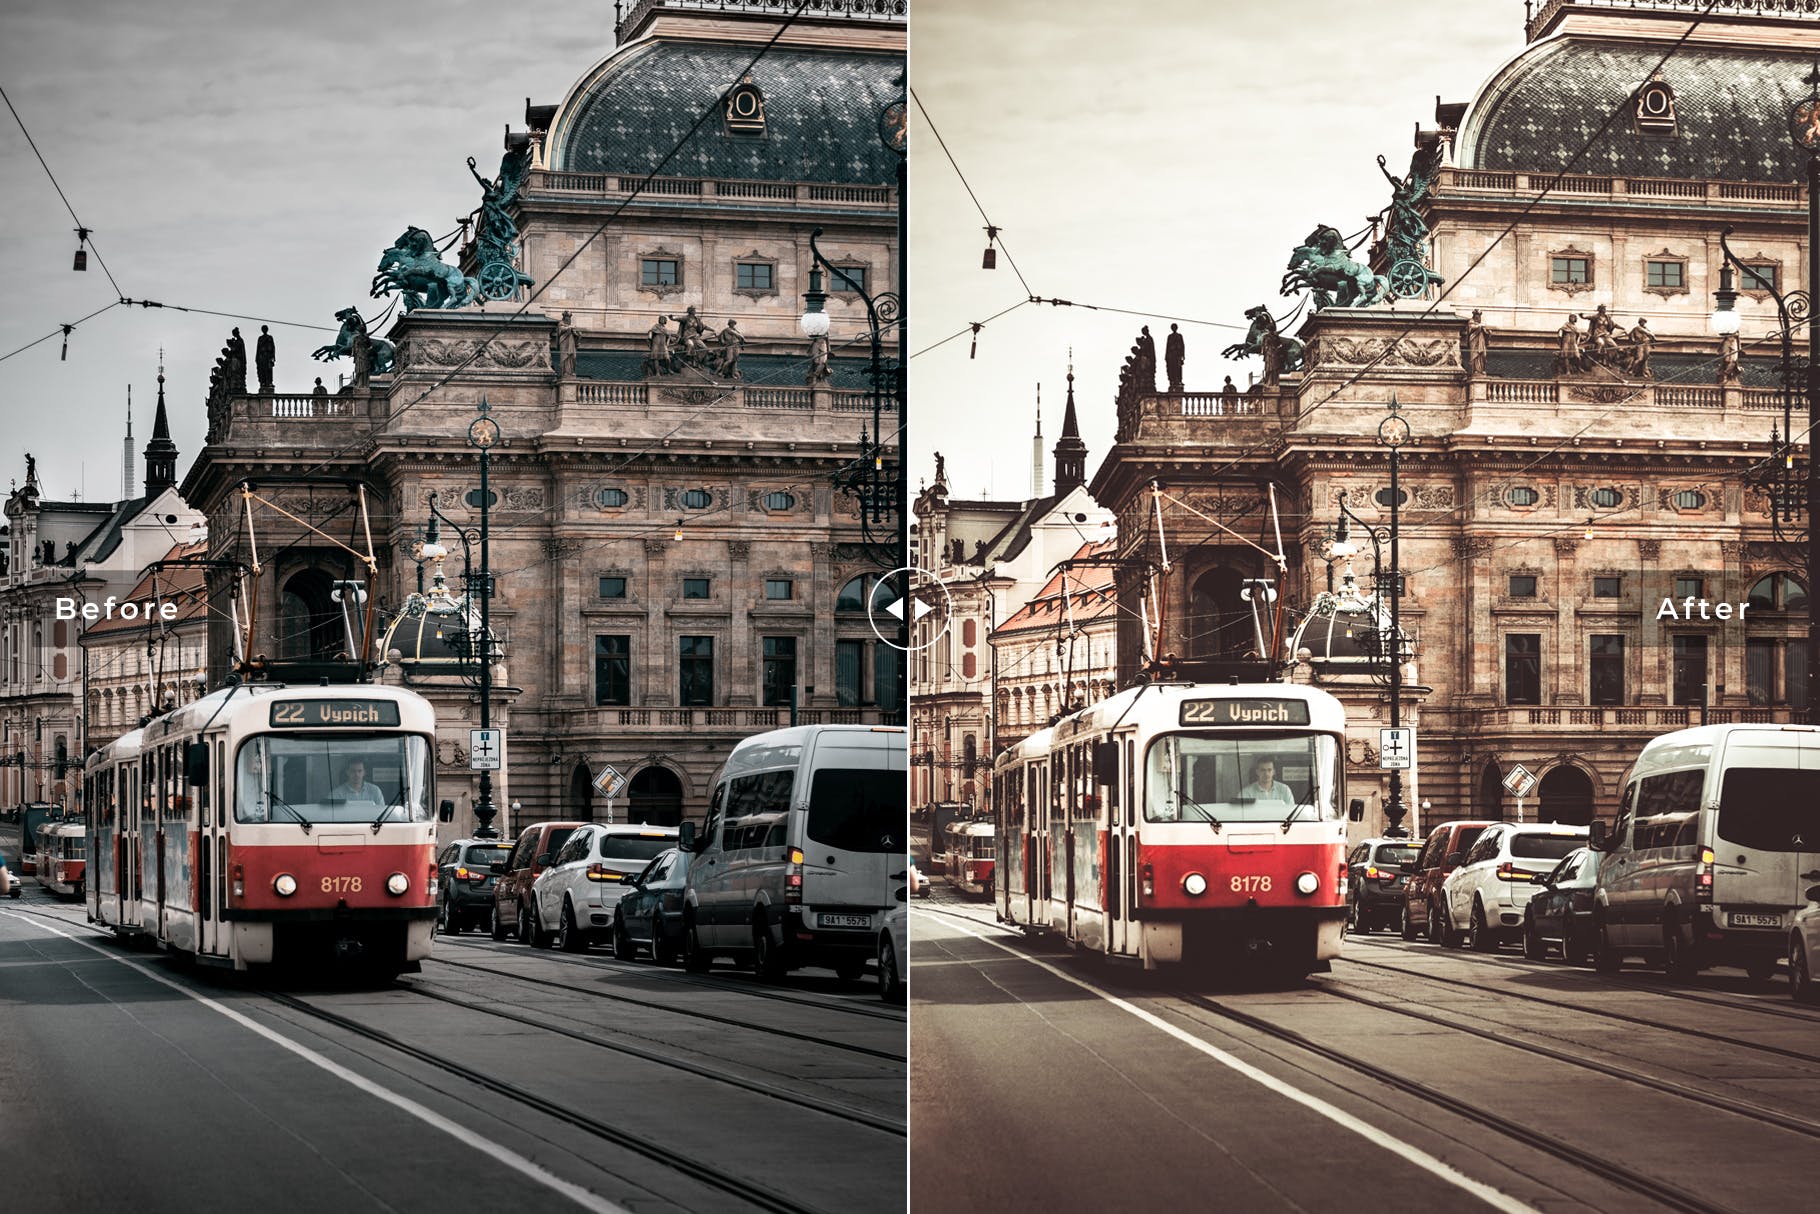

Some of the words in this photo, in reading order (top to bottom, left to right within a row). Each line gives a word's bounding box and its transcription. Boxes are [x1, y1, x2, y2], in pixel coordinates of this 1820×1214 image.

[275, 703, 305, 722] 22
[320, 703, 379, 722] Vypich
[1184, 701, 1215, 722] 22
[1229, 703, 1288, 721] Vypich
[321, 876, 362, 893] 8178
[1230, 875, 1272, 892] 8178
[825, 915, 840, 925] 9A1
[846, 916, 867, 926] 5575
[1735, 914, 1751, 924] 9A1
[1756, 915, 1778, 925] 5575
